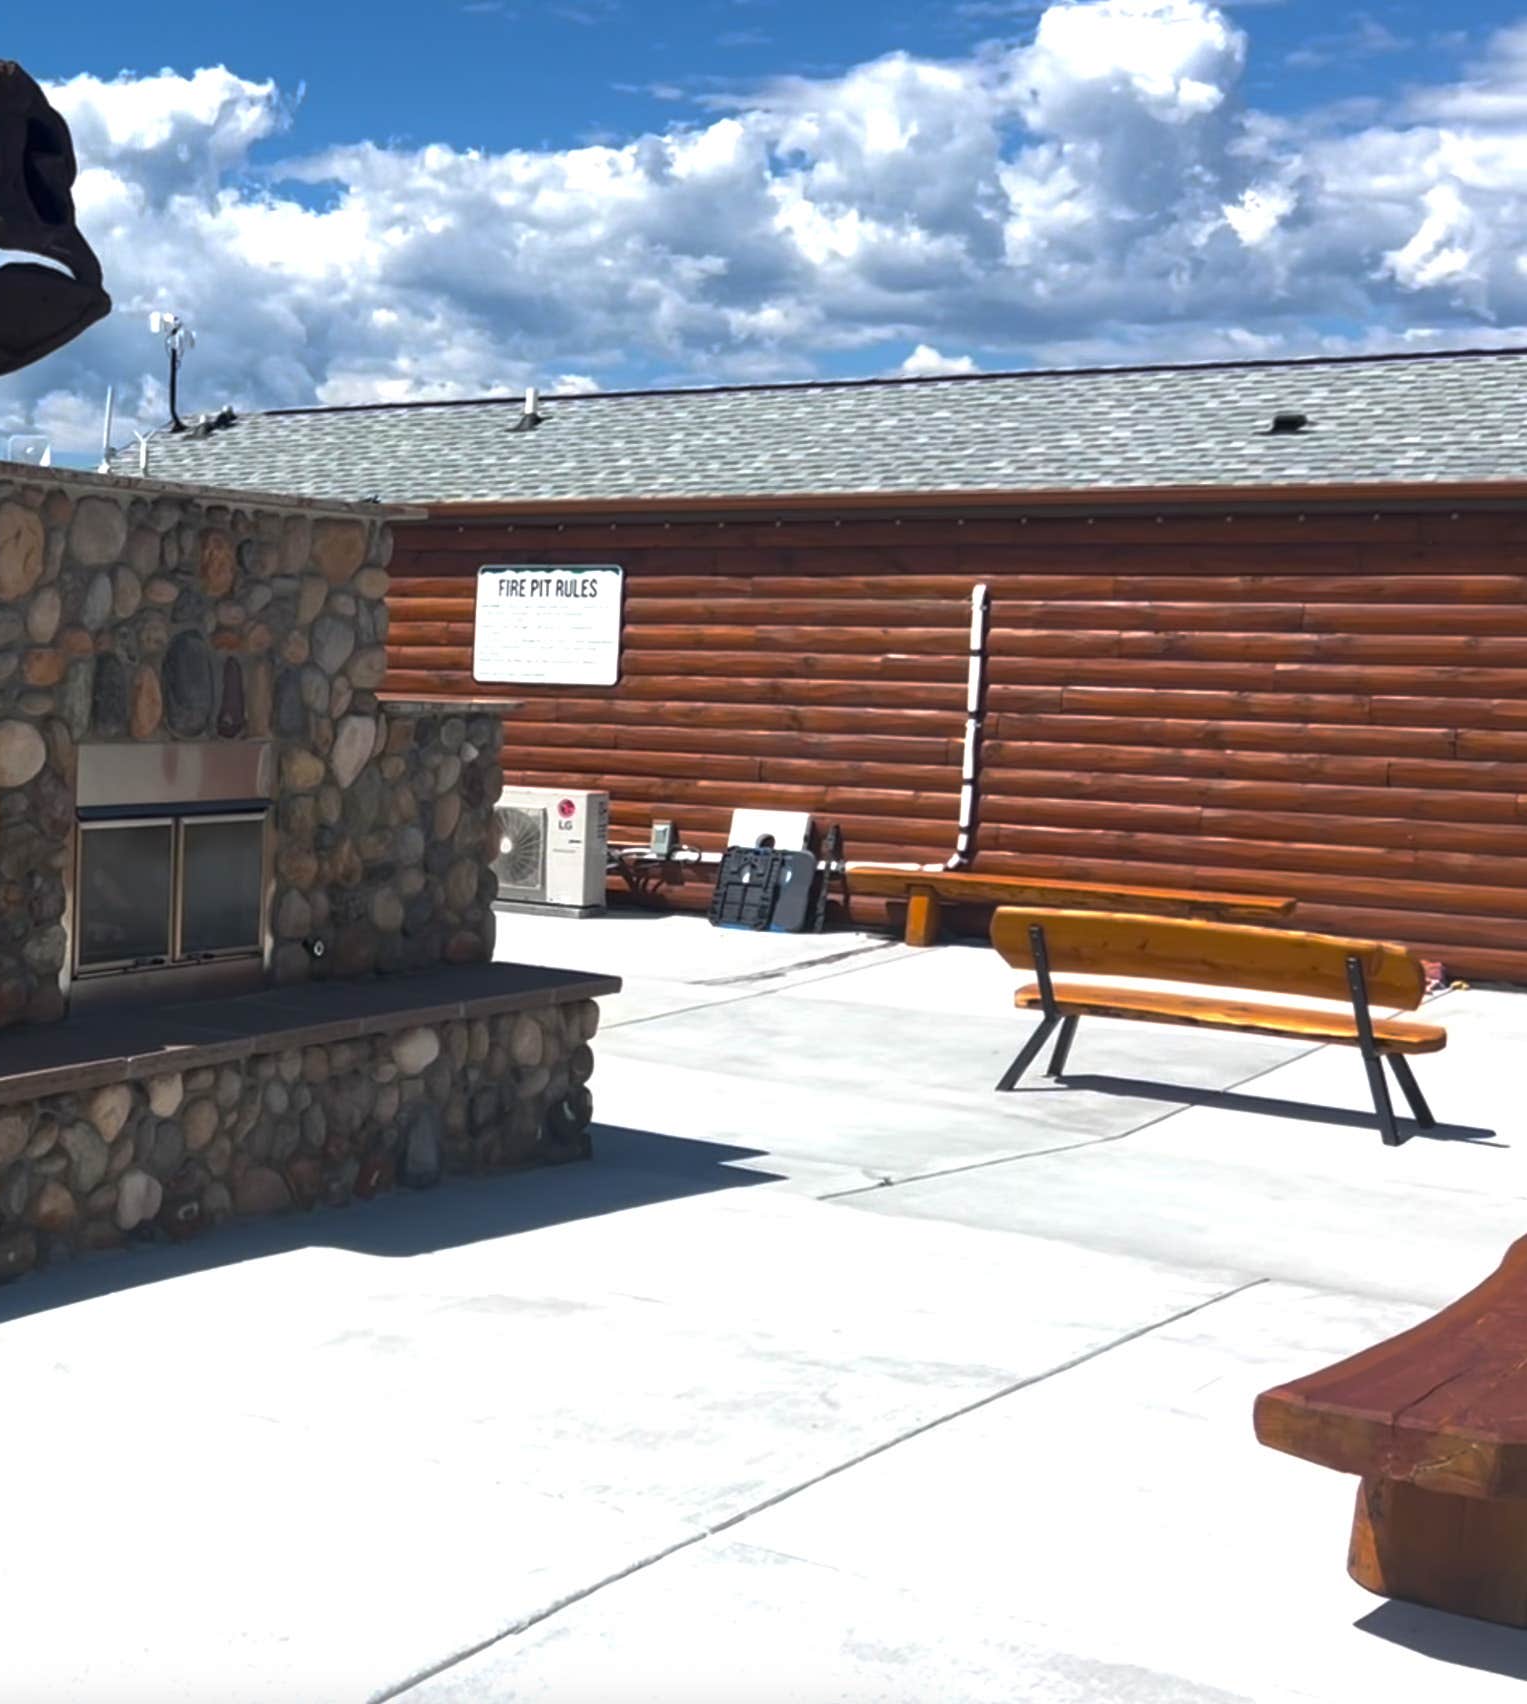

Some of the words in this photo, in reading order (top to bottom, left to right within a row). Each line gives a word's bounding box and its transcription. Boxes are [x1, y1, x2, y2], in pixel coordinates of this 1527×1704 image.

[498, 579, 526, 597] FIRE
[530, 579, 552, 597] PIT
[555, 578, 598, 598] RULES
[558, 819, 573, 831] LG
